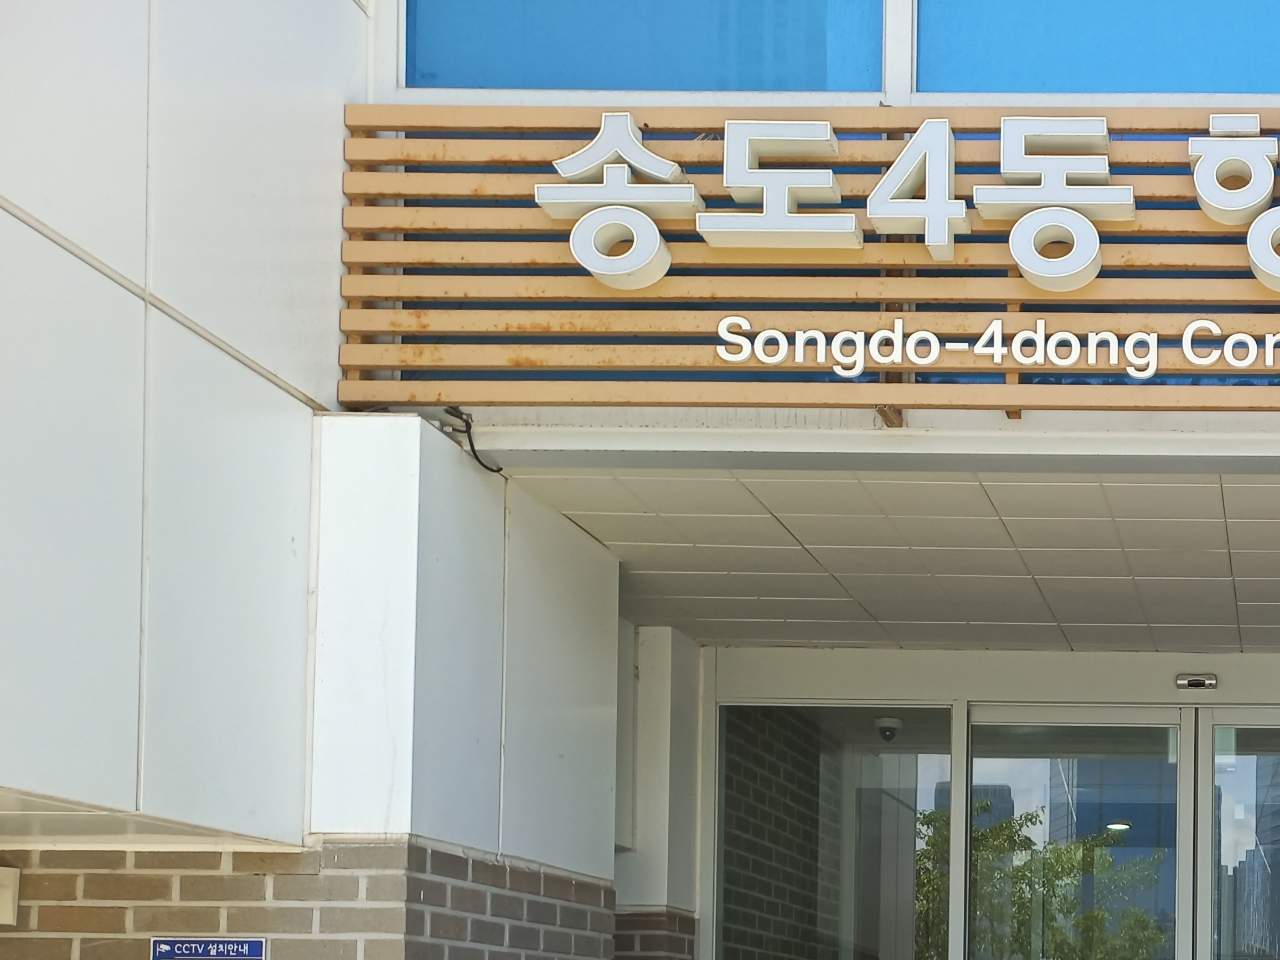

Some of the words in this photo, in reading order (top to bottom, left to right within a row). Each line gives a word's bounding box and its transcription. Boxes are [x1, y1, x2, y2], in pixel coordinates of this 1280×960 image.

[534, 112, 1136, 292] 송도4동
[716, 316, 1160, 379] Songdo-4dong
[174, 943, 205, 954] CCTV
[207, 943, 249, 956] 설치안내
